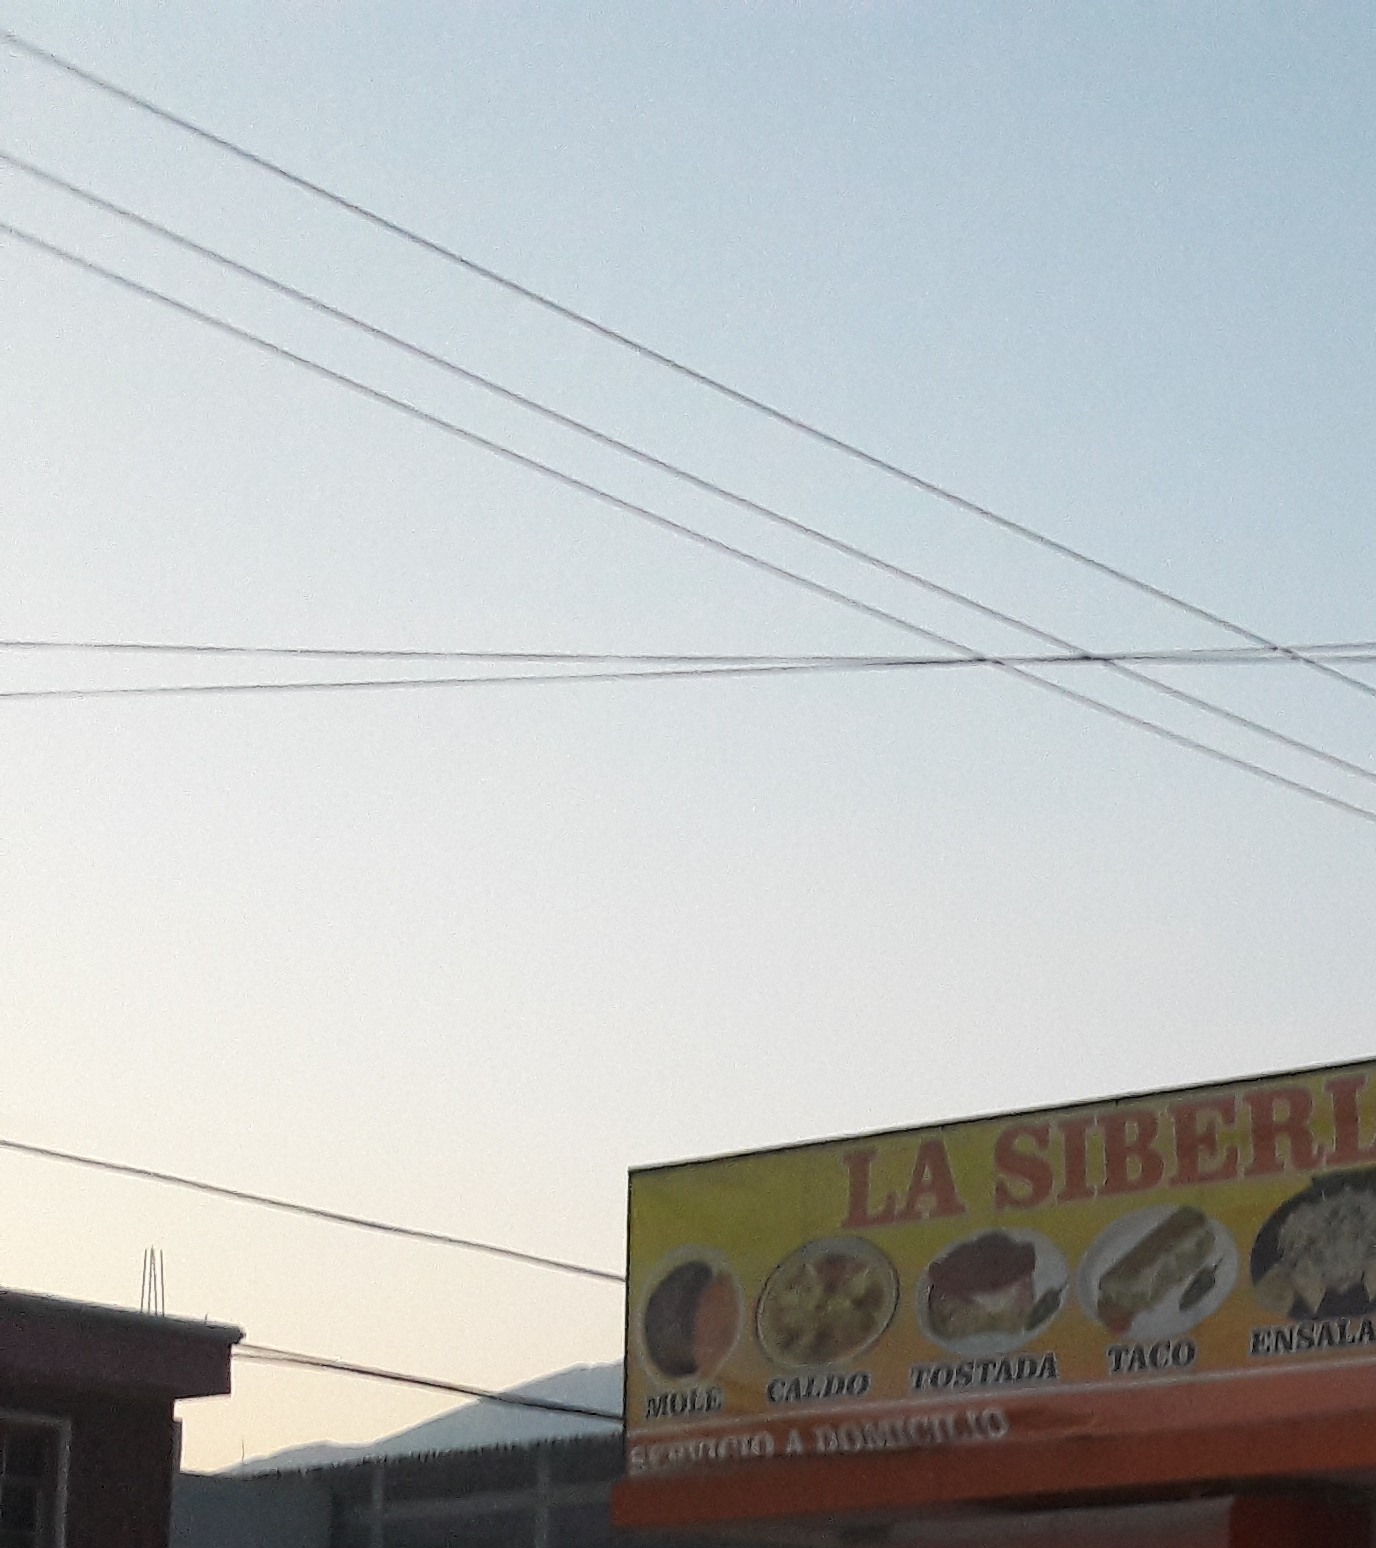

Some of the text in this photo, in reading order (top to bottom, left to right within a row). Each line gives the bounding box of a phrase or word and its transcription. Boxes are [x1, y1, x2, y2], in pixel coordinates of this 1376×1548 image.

[842, 1138, 966, 1230] LA
[910, 1353, 1058, 1391] TOSTADA
[1108, 1340, 1195, 1373] TACO
[645, 1387, 722, 1420] MOLE
[767, 1371, 871, 1404] CALDO
